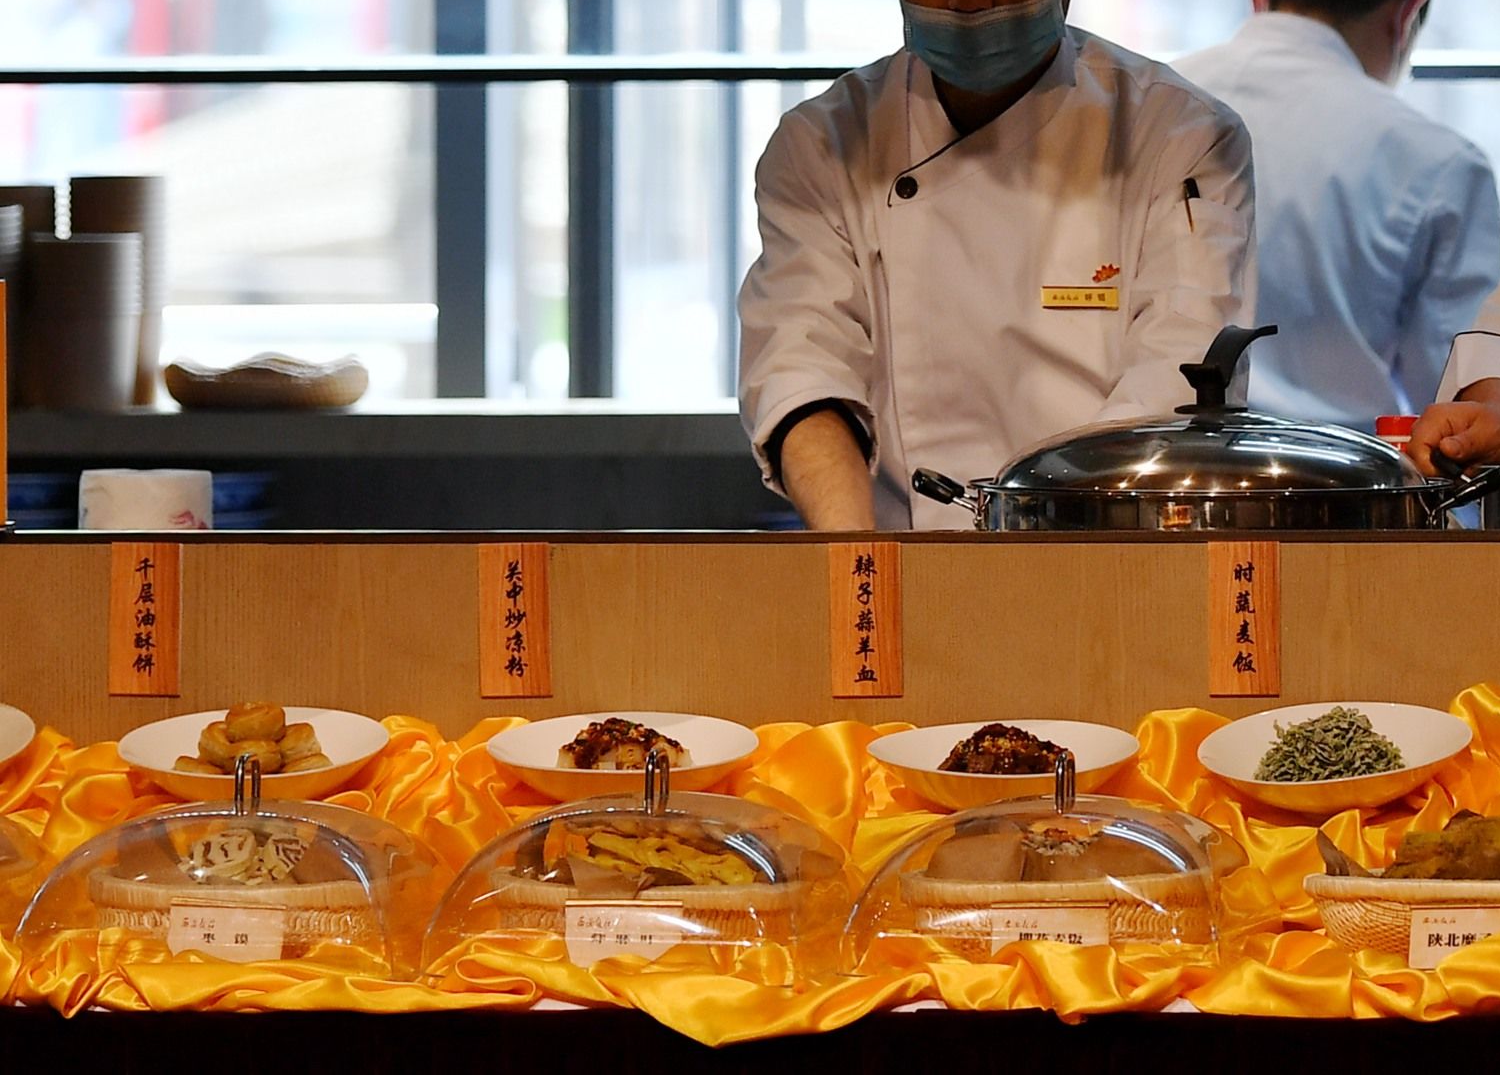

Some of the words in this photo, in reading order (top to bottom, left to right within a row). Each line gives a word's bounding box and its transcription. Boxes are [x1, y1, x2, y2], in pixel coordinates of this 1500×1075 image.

[132, 557, 156, 675] 千层油酥饼
[504, 560, 527, 678] 关中炒凉粉
[852, 553, 878, 683] 辣子蒜羊血
[1232, 561, 1257, 673] 时蔬麦饭
